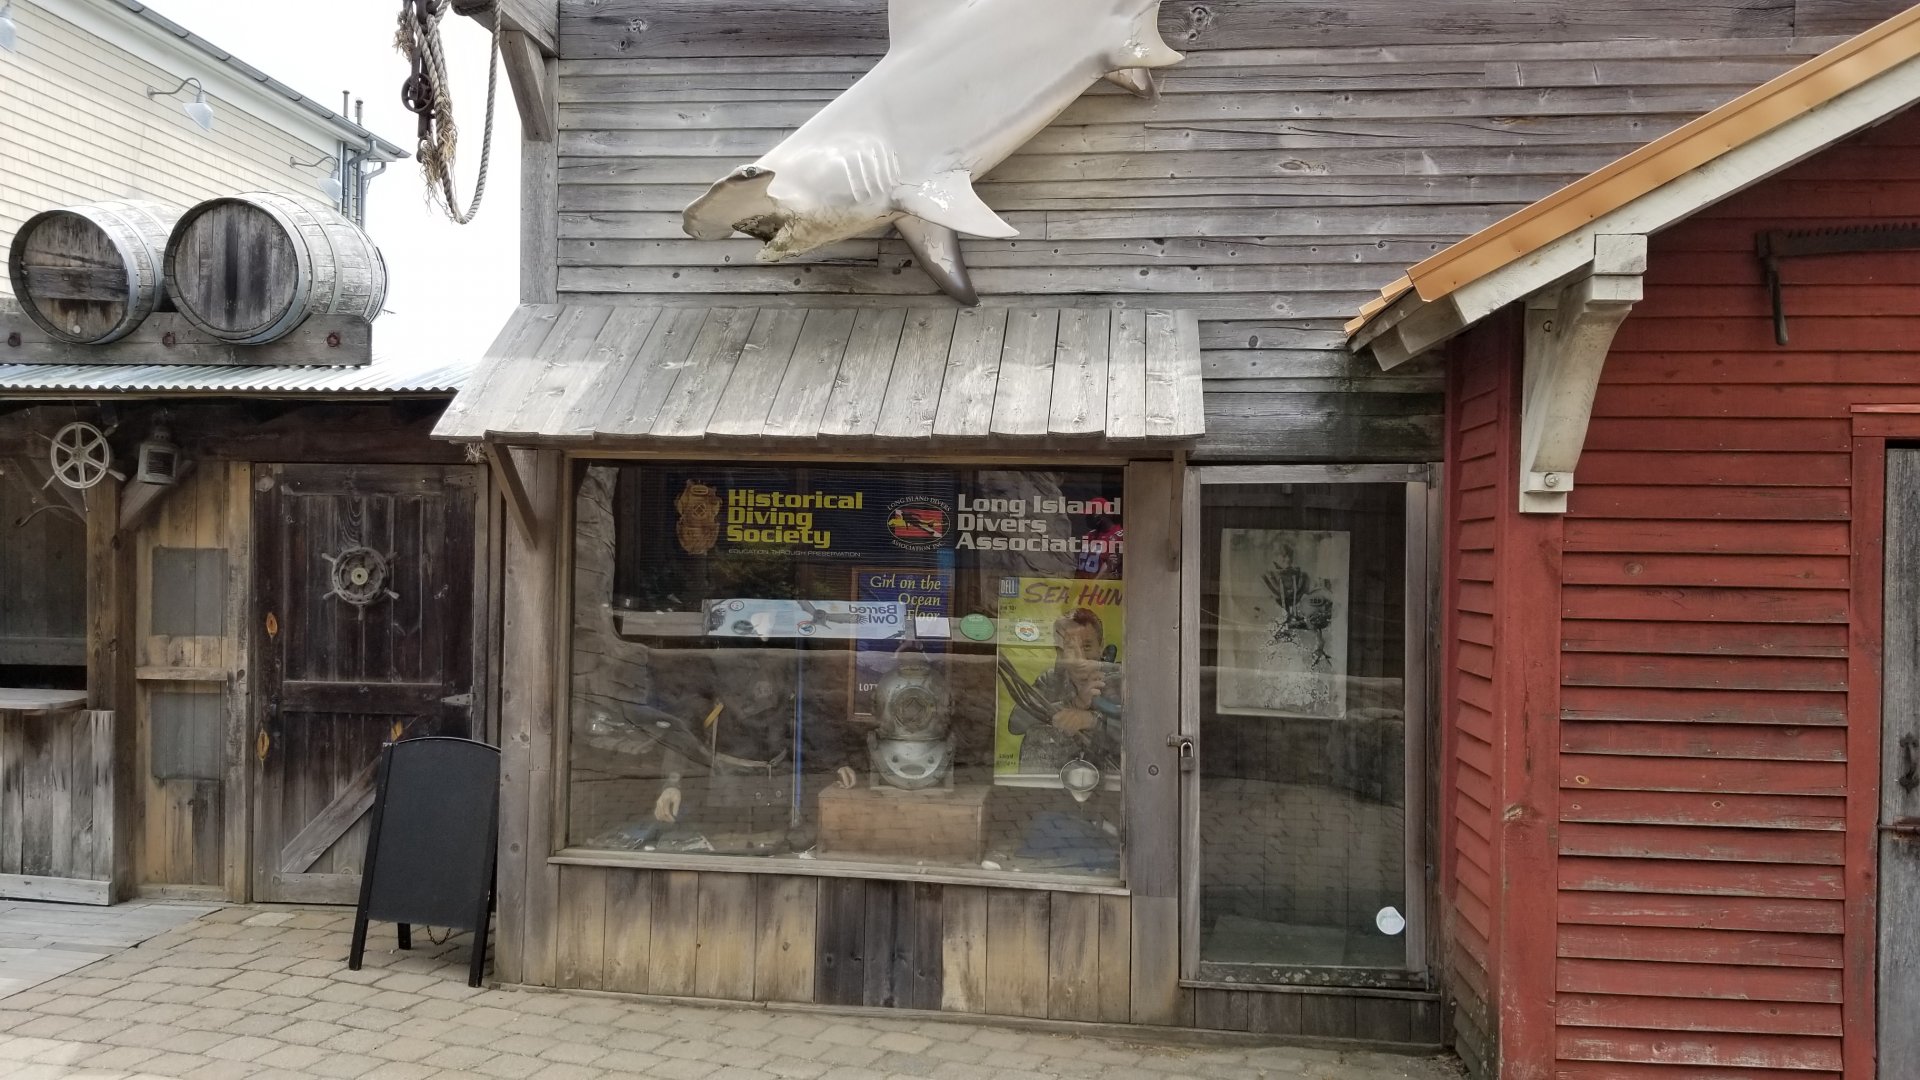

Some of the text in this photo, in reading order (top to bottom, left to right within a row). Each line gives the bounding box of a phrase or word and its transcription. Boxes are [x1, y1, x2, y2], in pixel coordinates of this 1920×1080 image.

[728, 489, 863, 510] Historical
[887, 495, 952, 511] LONG ISLAND DIVERS
[957, 493, 1121, 518] Long Island
[727, 506, 813, 530] Diving
[957, 513, 1047, 533] Divers
[727, 524, 831, 549] Society
[955, 532, 1123, 554] Association
[728, 548, 861, 558] EDUCATION THROUGH PRESERVATION
[870, 573, 941, 591] Girl on the
[1000, 579, 1016, 594] DELL
[898, 592, 941, 607] Ocean
[1023, 582, 1071, 605] SEA
[907, 603, 940, 621] Floor
